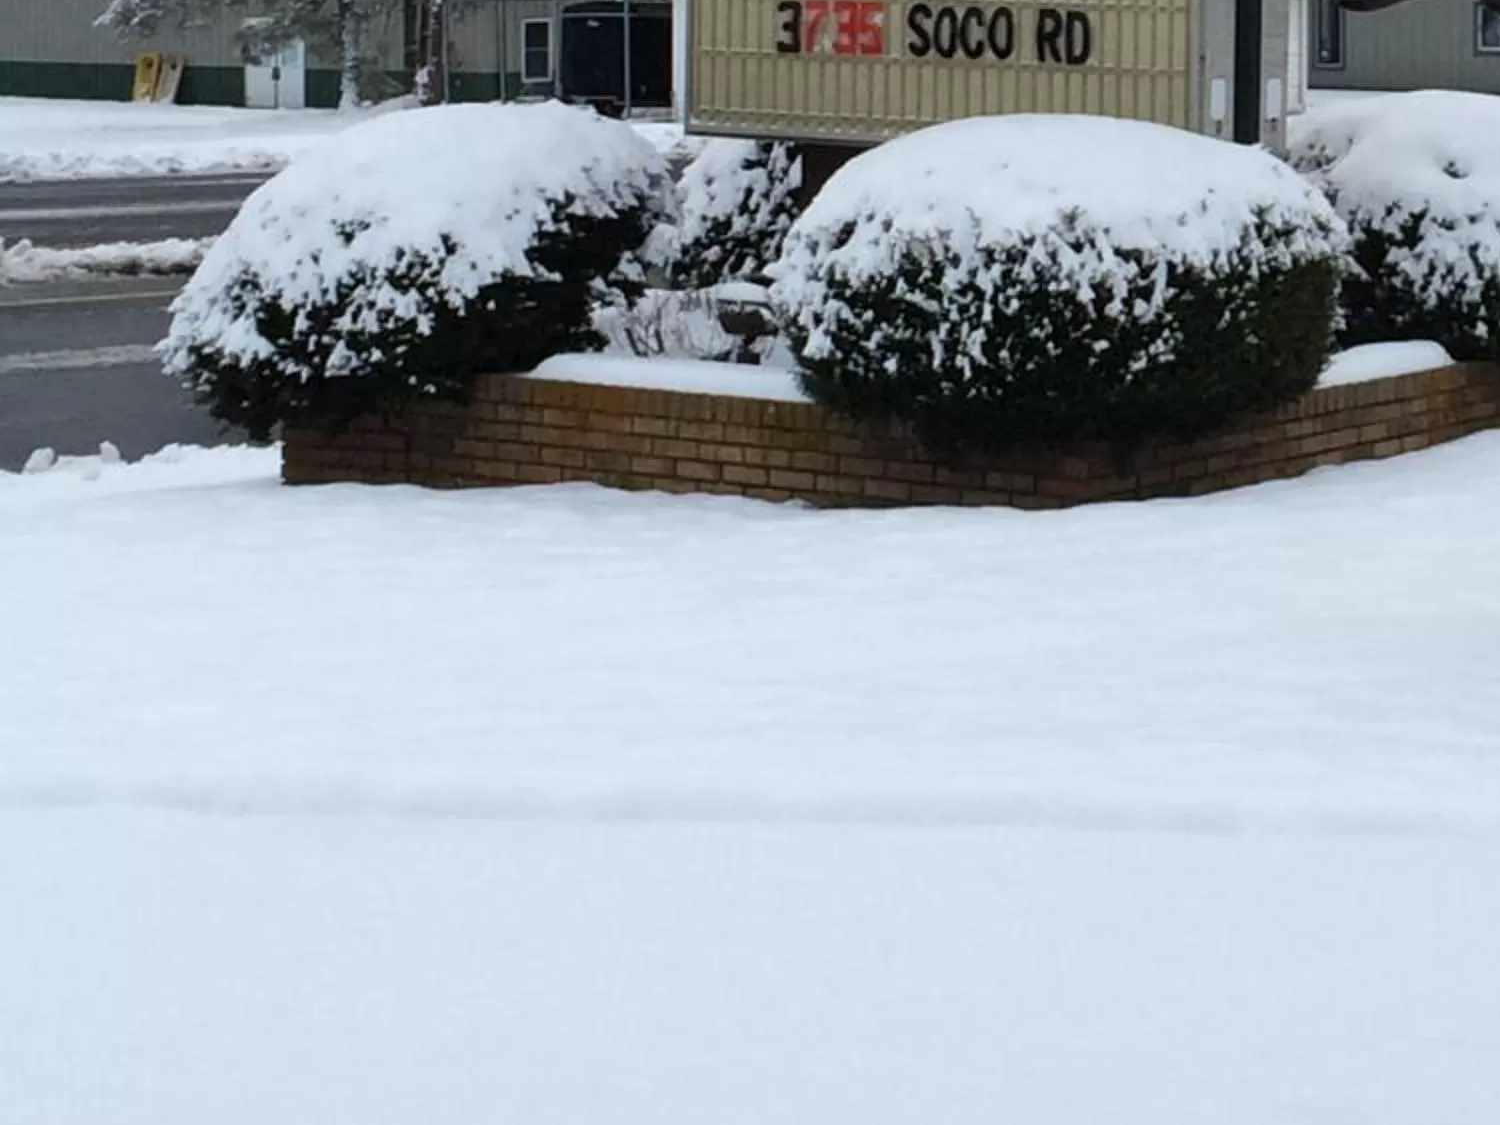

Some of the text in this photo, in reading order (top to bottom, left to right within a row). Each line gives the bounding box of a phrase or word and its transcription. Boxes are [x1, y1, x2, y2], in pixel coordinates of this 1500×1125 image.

[776, 0, 1092, 66] 3735 SOCO RD
